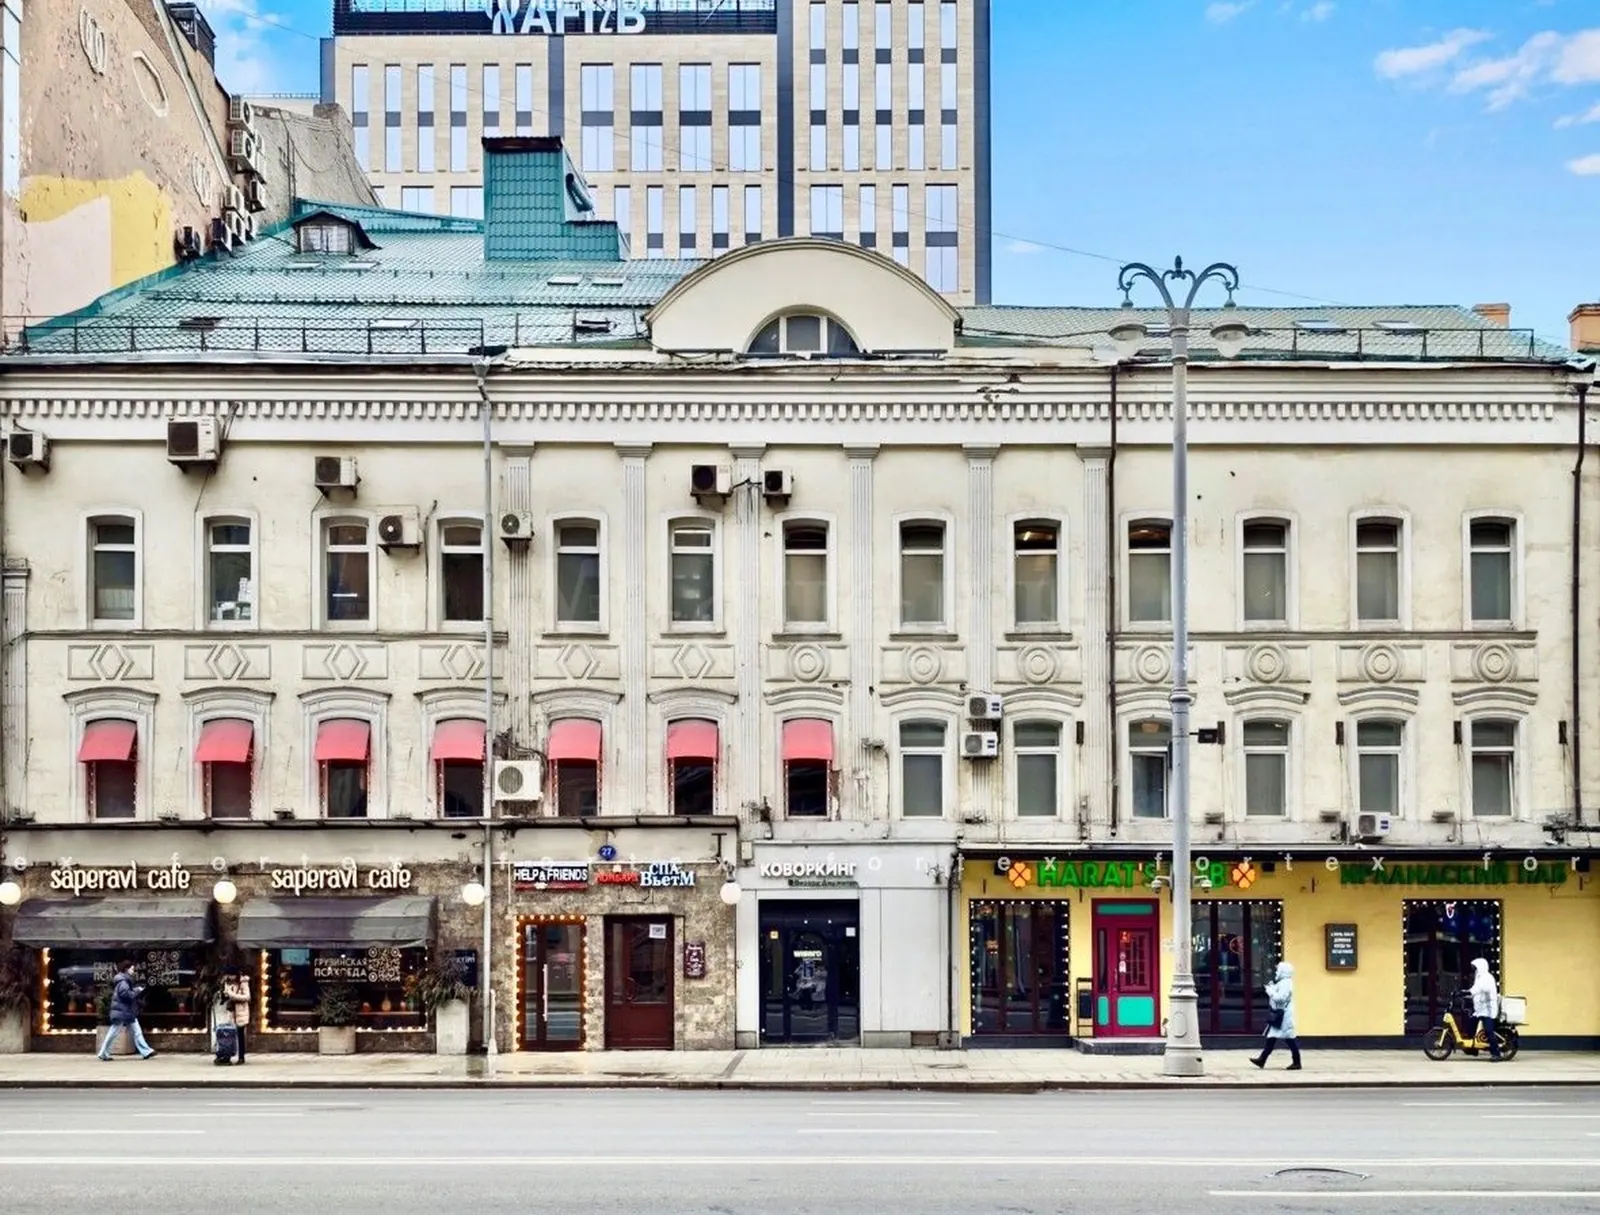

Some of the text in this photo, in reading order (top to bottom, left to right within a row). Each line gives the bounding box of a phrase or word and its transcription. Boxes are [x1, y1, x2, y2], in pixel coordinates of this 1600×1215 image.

[601, 847, 612, 857] 27
[50, 860, 191, 896] saperavi cafe
[272, 861, 412, 896] saperavi cafe
[649, 863, 680, 875] СПА
[760, 862, 857, 877] КОВОРКИНГ
[1037, 861, 1158, 888] HARAT'S
